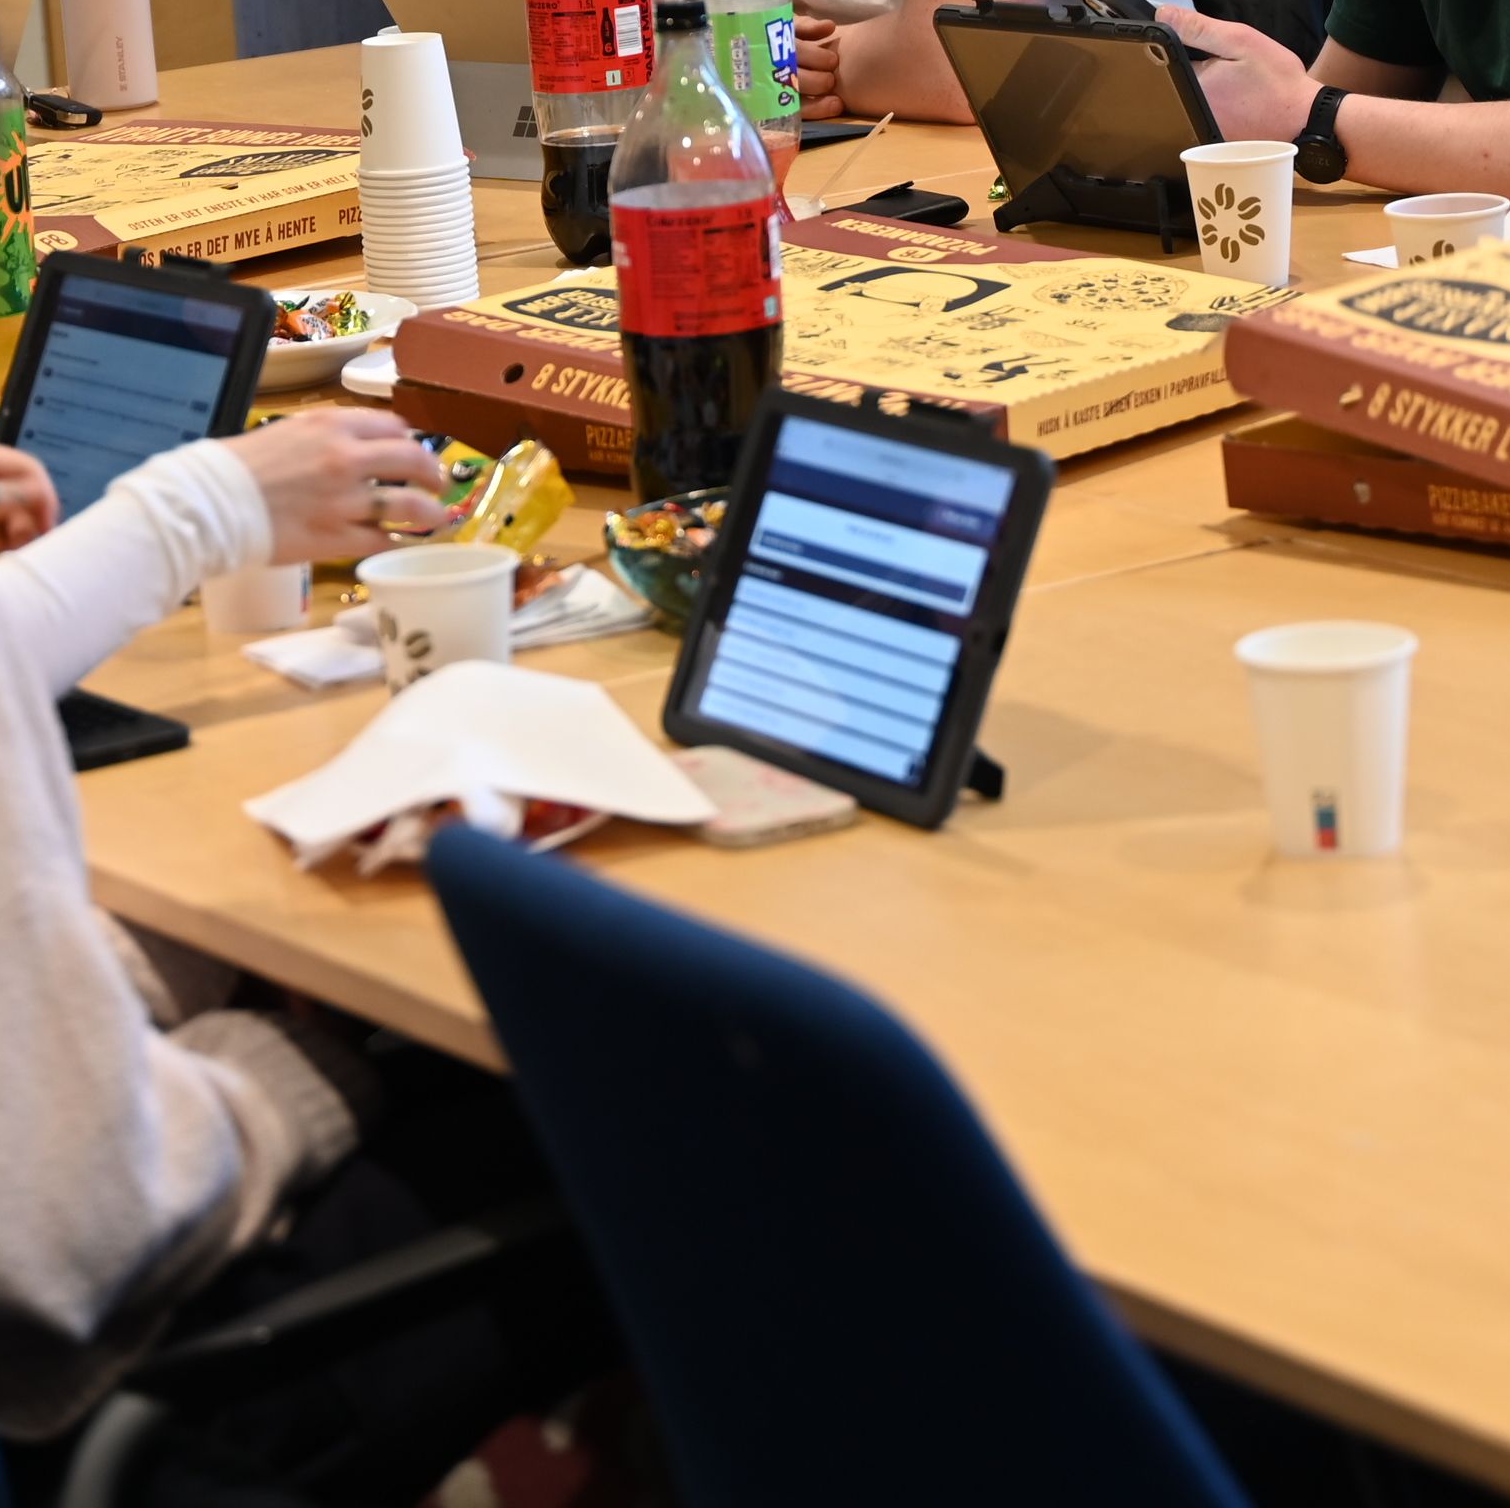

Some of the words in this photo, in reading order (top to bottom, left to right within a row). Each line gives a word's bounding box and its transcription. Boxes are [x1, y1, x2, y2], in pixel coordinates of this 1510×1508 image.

[765, 19, 796, 63] FA
[128, 217, 164, 231] OSTEN
[165, 213, 181, 222] ER
[181, 208, 203, 219] DET
[204, 198, 246, 213] ENESTE
[246, 195, 260, 205] VI
[261, 190, 281, 202] HAR
[282, 185, 307, 196] SOM
[307, 181, 322, 190] ER
[323, 174, 348, 186] HELT
[39, 233, 69, 252] PB
[187, 241, 202, 259] ER
[206, 235, 230, 257] DET
[235, 228, 261, 251] MYE
[265, 220, 274, 243] Å
[278, 215, 317, 241] HENTE
[338, 205, 363, 226] PIZZ
[531, 363, 556, 390] 8
[1388, 388, 1500, 454] STYKKER
